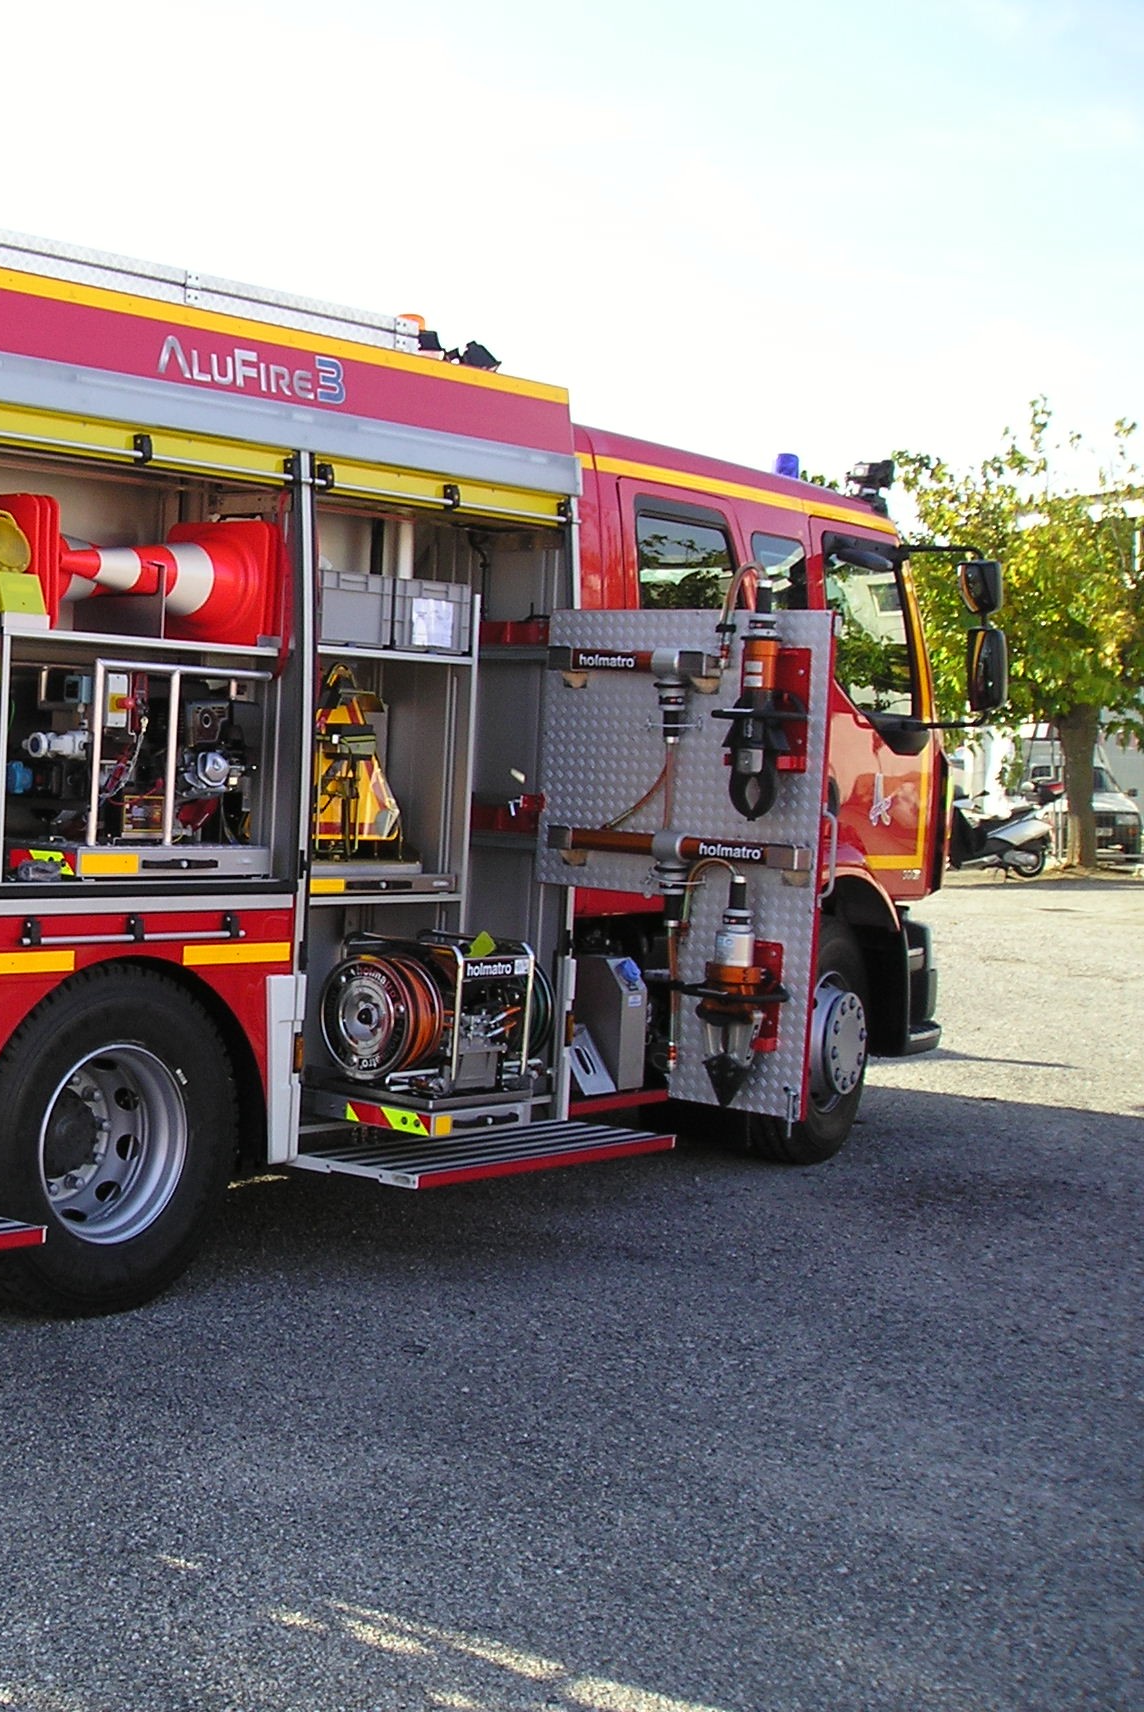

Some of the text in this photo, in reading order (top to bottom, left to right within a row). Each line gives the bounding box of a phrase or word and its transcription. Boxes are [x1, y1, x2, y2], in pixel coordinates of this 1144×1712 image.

[578, 653, 636, 669] holmatro
[699, 842, 763, 860] holmatro
[466, 961, 513, 977] holmatro
